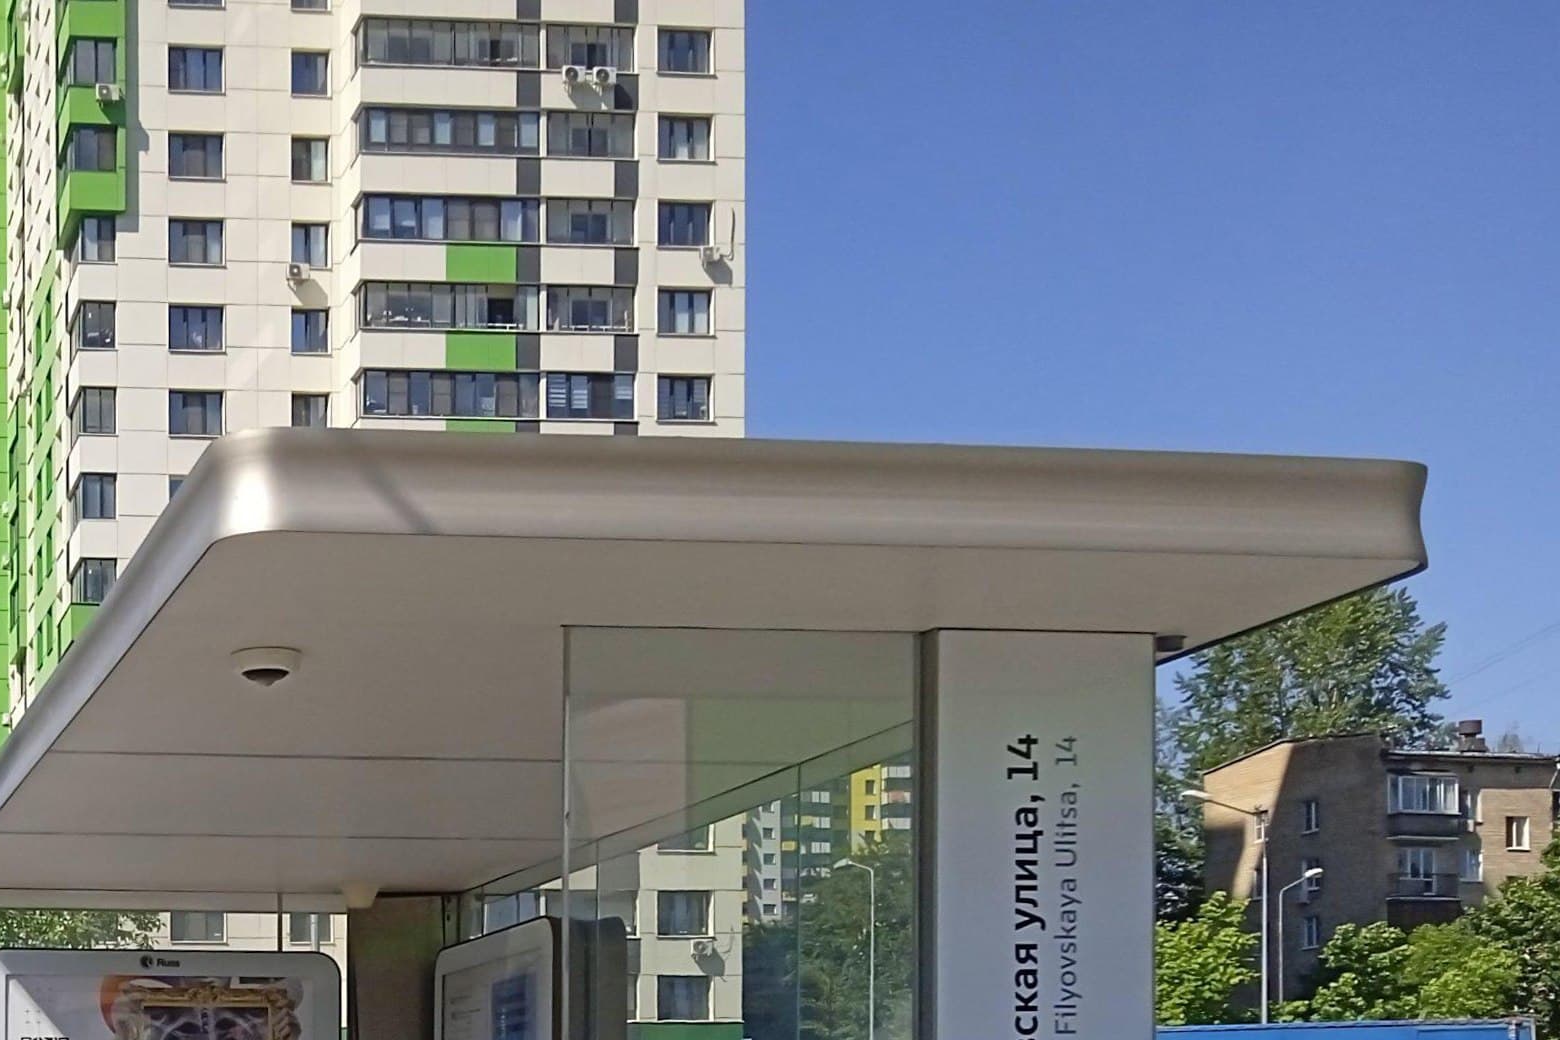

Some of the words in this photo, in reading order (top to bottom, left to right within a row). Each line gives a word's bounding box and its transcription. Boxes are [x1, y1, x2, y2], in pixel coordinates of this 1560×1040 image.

[1007, 734, 1038, 780] 14
[1055, 736, 1077, 766] 14
[1015, 795, 1046, 931] улица,
[1053, 783, 1081, 867] Ulitsa,
[1053, 878, 1082, 1038] Filyovskaya
